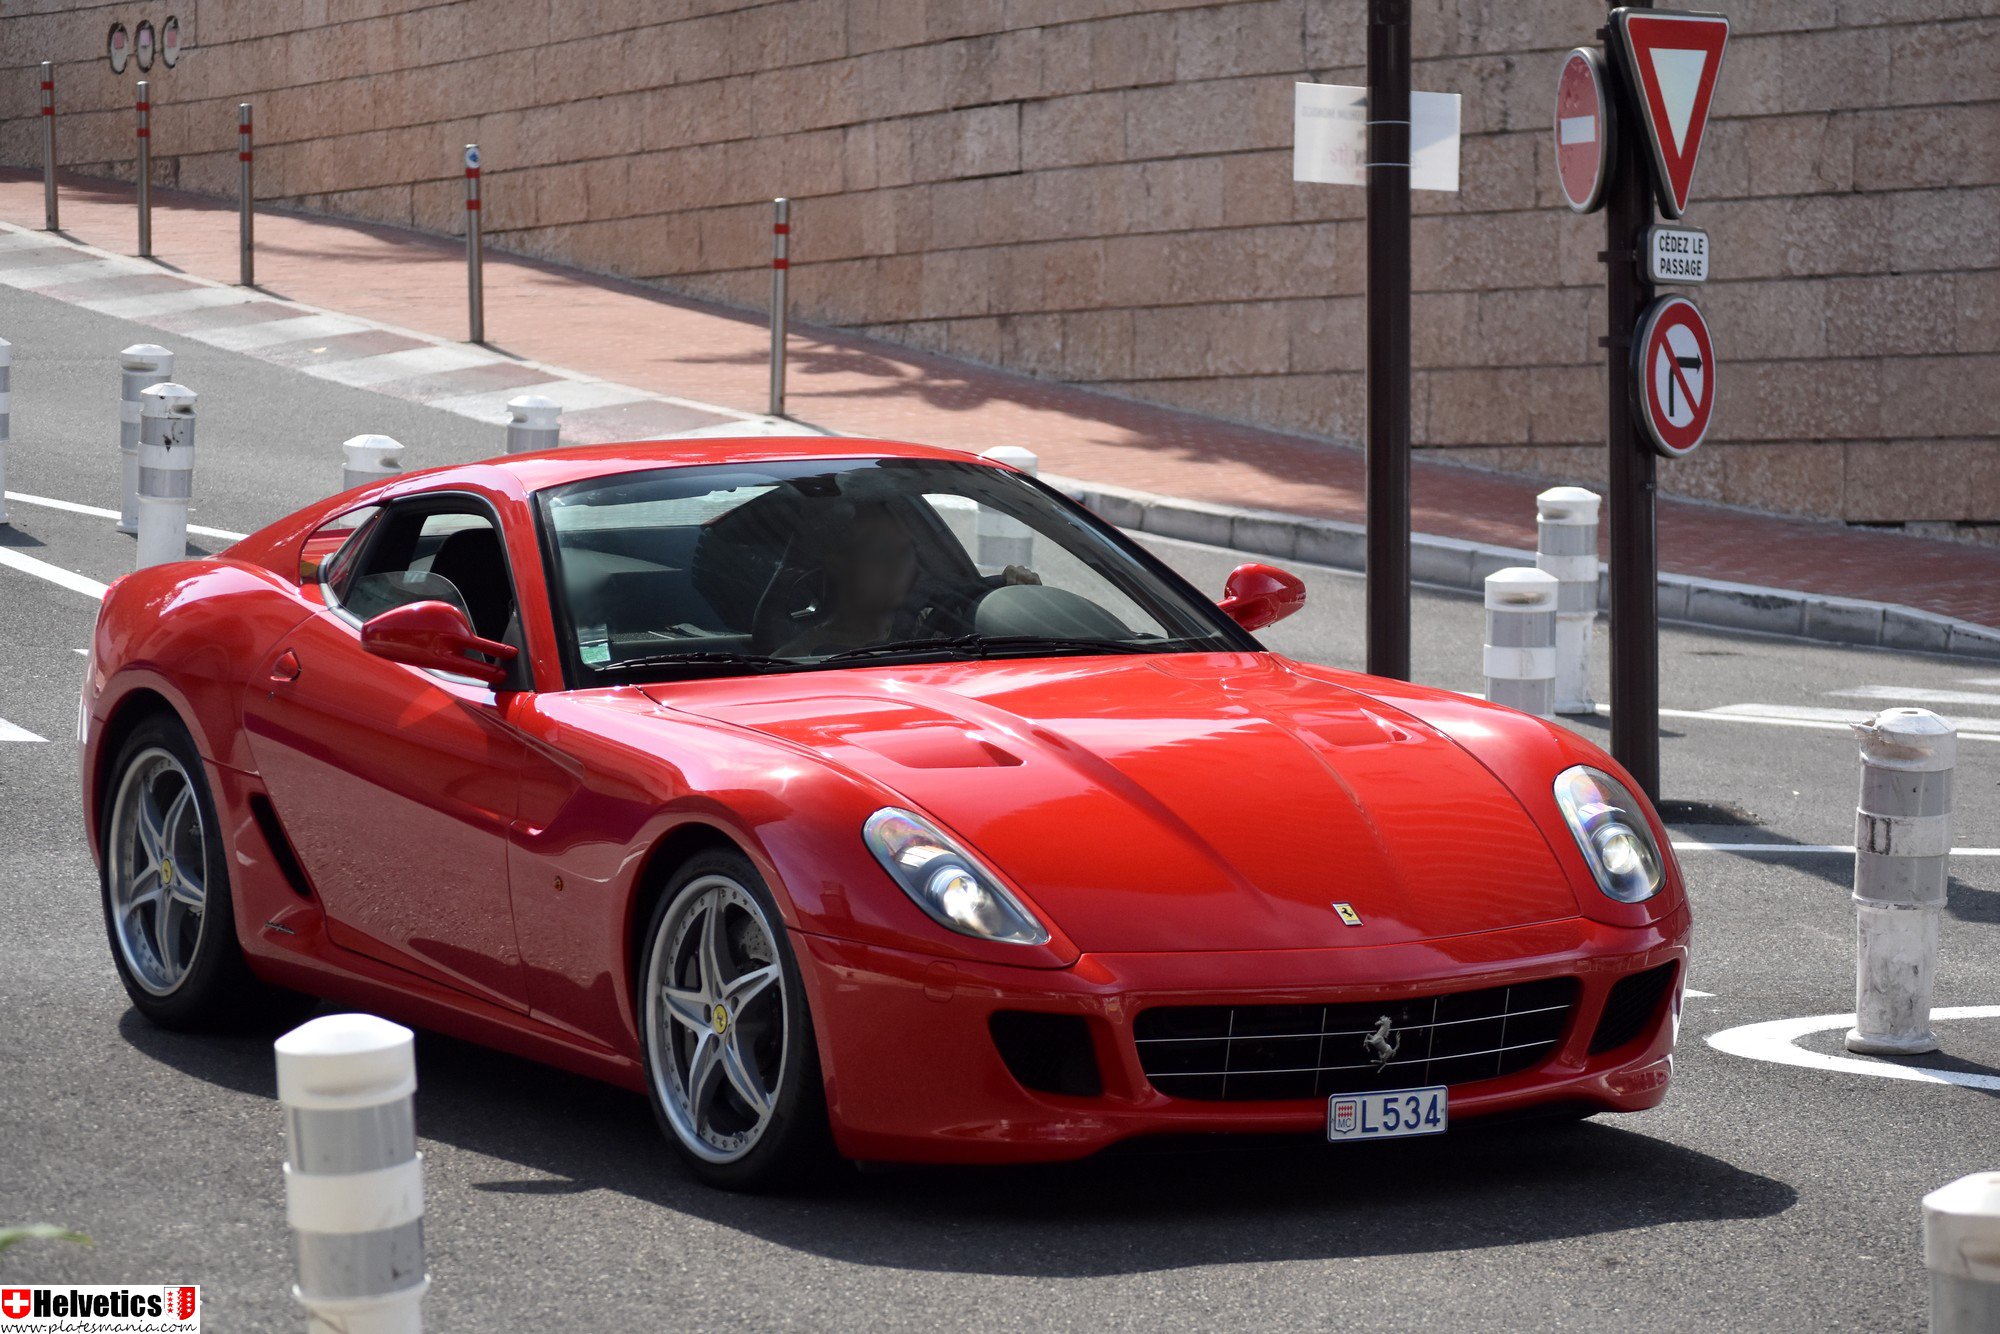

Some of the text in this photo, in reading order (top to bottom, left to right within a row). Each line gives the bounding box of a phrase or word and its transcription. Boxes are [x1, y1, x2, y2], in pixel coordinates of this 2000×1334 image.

[1659, 232, 1704, 255] CÉDEZ LE
[1660, 257, 1702, 277] PASSAGE
[1337, 1093, 1441, 1133] MC L534
